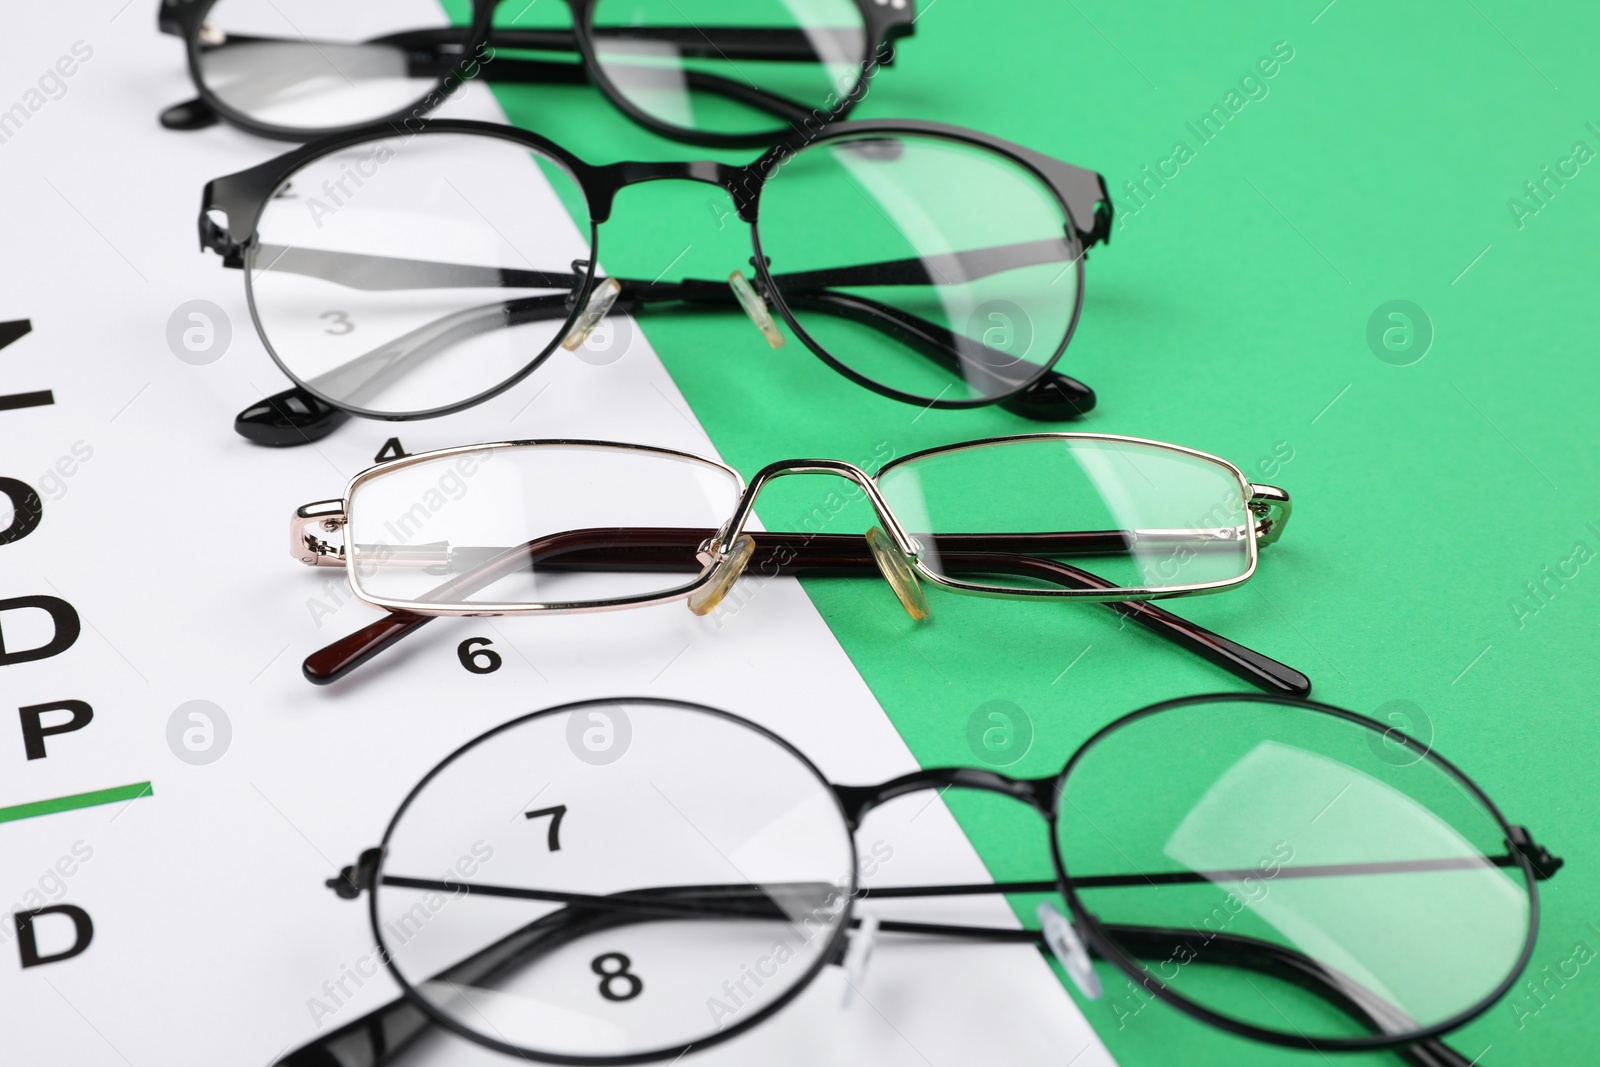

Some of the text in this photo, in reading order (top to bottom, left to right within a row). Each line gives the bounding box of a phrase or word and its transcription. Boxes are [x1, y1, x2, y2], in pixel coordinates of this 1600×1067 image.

[318, 310, 356, 336] 3
[373, 437, 413, 463] 4
[457, 636, 502, 674] 6
[18, 699, 94, 761] P
[524, 804, 567, 852] 7
[13, 903, 94, 970] D
[590, 952, 643, 1003] 8
